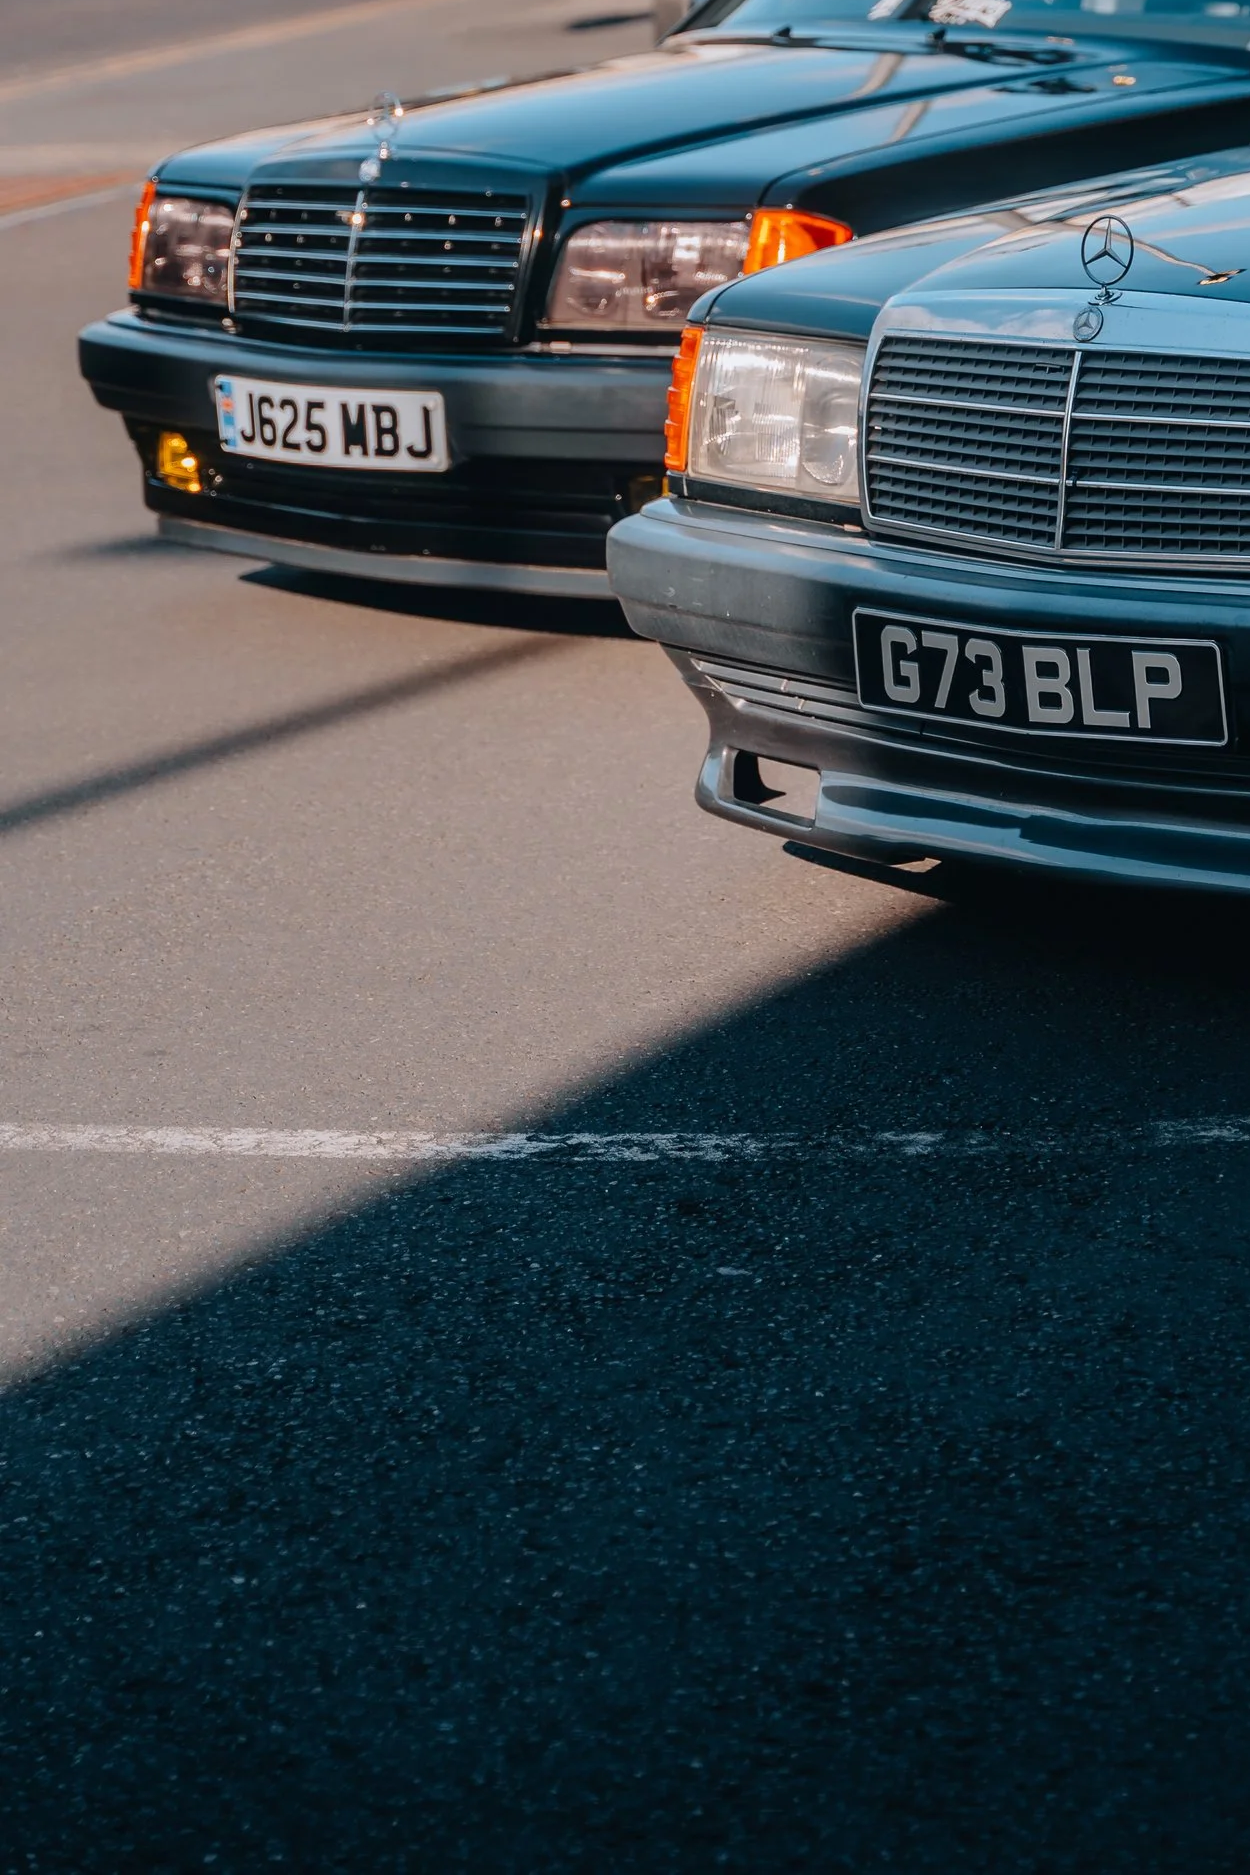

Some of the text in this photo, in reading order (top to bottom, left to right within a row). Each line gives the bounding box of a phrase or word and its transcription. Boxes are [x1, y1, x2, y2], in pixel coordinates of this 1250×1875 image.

[240, 392, 433, 458] J625 MBJ
[880, 625, 1182, 729] G73 BLP
